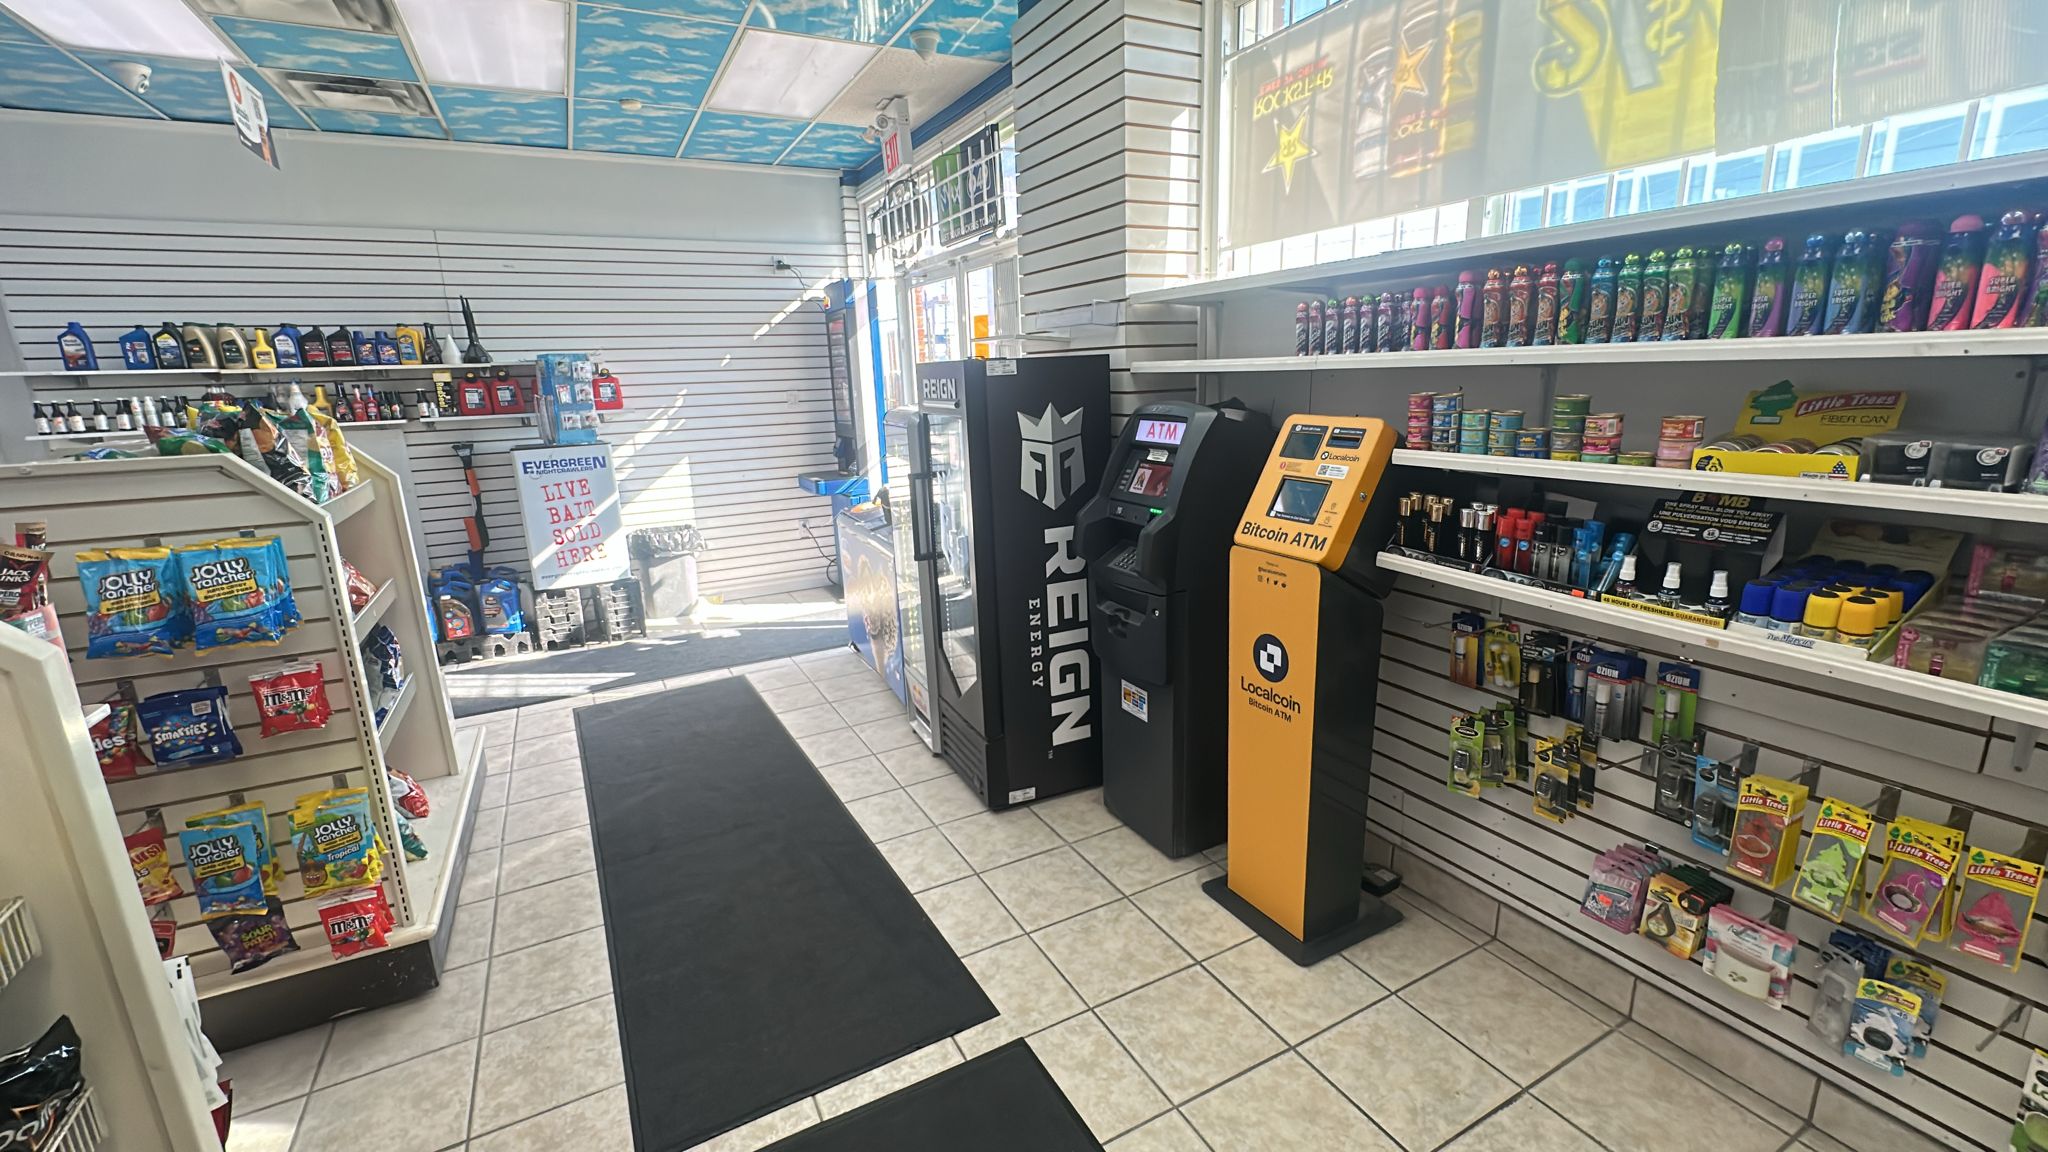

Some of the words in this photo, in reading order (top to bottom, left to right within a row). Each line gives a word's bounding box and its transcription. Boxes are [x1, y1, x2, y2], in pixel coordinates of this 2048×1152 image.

[885, 132, 900, 174] EXIT
[1986, 285, 2016, 294] BRIGHT
[1989, 276, 2015, 285] SUPER
[922, 378, 957, 399] REIGN
[1797, 397, 1849, 416] Little
[1850, 393, 1896, 406] Trees
[1820, 414, 1855, 425] FIBER
[1861, 415, 1891, 425] CAN
[1146, 422, 1178, 441] ATM
[522, 456, 607, 475] EVERGREEN
[1329, 453, 1360, 462] Localcoin
[536, 465, 593, 476] NIGHTCRAWLERS
[541, 478, 591, 503] LIVE
[547, 500, 597, 524] BAIT
[552, 521, 601, 545] SOLD
[1241, 521, 1289, 544] Bitcoin
[1290, 531, 1328, 551] ATM
[556, 543, 608, 568] HERE
[0, 568, 31, 576] JACK
[100, 569, 154, 593] JOLLY
[193, 559, 246, 583] JOLLY
[197, 571, 252, 590] rancher
[101, 583, 156, 600] rancher
[1611, 598, 1630, 608] HOURS
[1640, 605, 1674, 617] FRESHNESS
[1675, 612, 1720, 626] GUARANTEED!
[1029, 598, 1044, 687] ENERGY
[1044, 525, 1092, 746] REIGN
[1576, 652, 1591, 662] OZIU
[1596, 665, 1619, 679] OZIUM
[1665, 674, 1691, 687] OZIUM
[1241, 675, 1301, 714] Localcoin
[1248, 697, 1273, 715] Bitcoin
[1274, 709, 1292, 723] ATM
[1746, 784, 1753, 793] 1
[1741, 796, 1763, 805] Little
[1766, 800, 1788, 811] Trees
[314, 815, 353, 838] JOLLY
[317, 824, 358, 844] rancher
[1819, 818, 1843, 831] Little
[1844, 824, 1867, 838] Trees
[1866, 822, 1872, 830] 1
[190, 837, 235, 859] JOLLY
[194, 846, 241, 867] rancher
[327, 843, 360, 862] Tropical
[1897, 844, 1923, 859] Little
[1924, 852, 1950, 869] Trees
[1950, 854, 1956, 862] 1
[1968, 866, 2001, 877] Little
[2005, 871, 2036, 886] Trees
[2035, 866, 2041, 874] 1
[241, 925, 273, 942] SOUR
